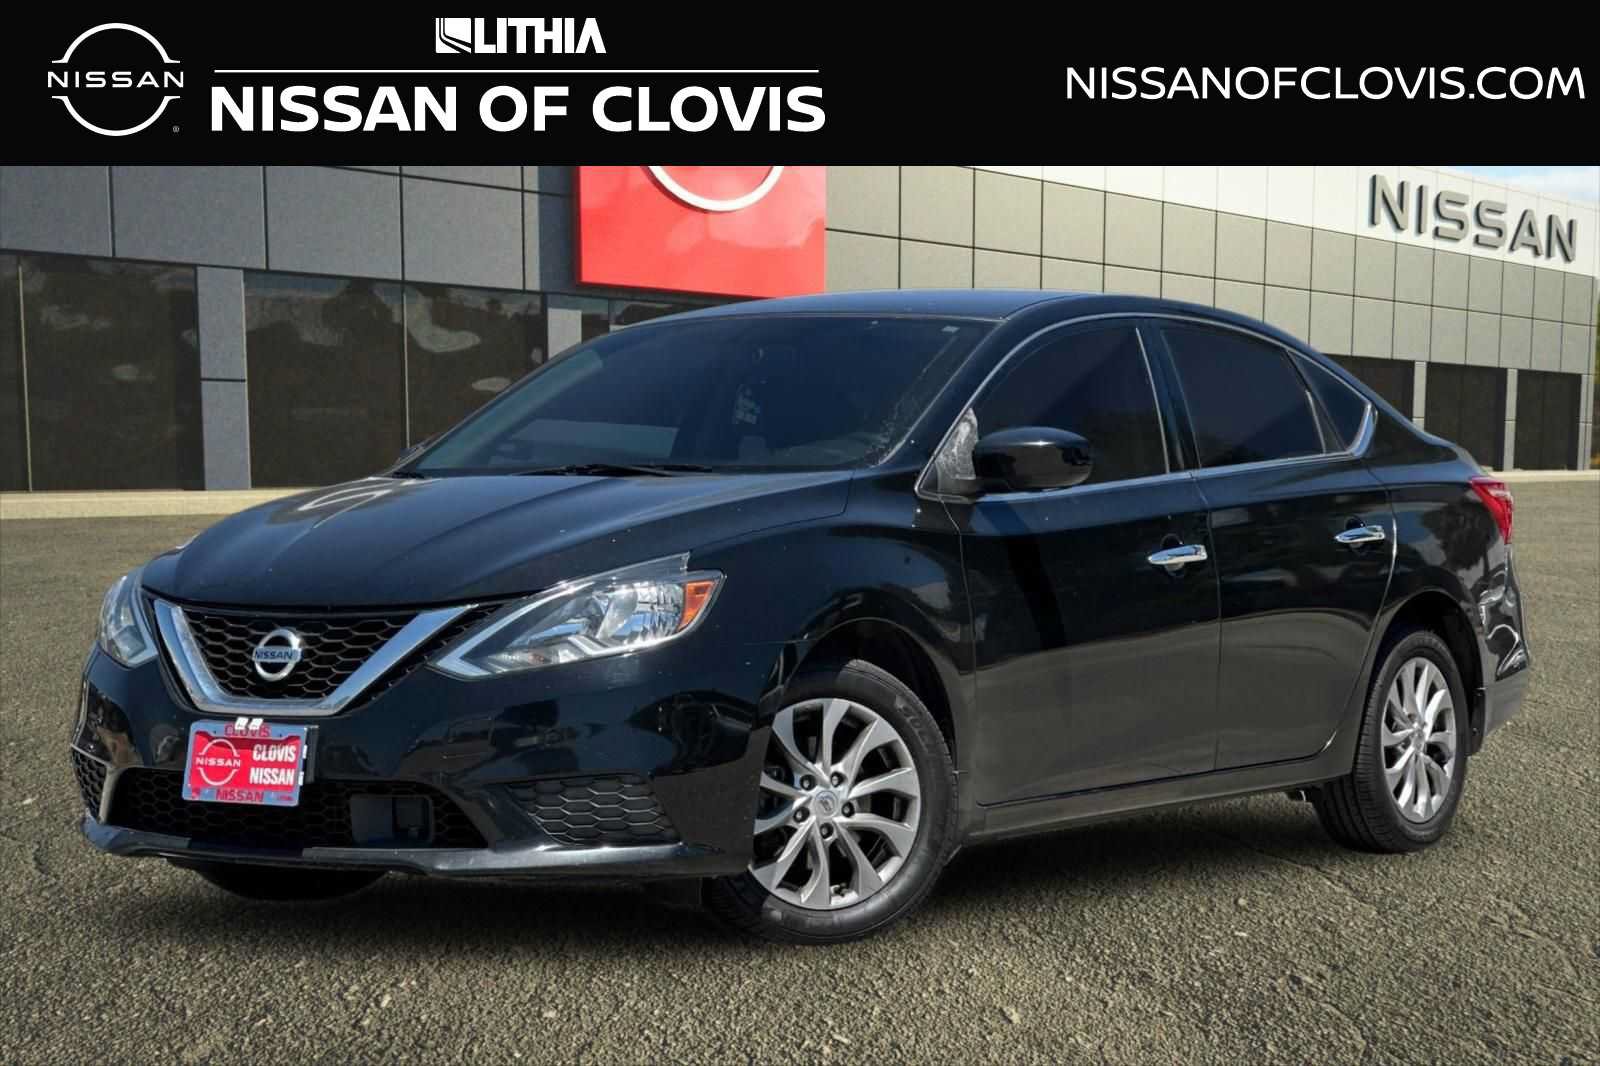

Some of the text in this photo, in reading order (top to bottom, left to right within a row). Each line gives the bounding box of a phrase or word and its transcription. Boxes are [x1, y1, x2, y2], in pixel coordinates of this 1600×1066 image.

[1368, 173, 1577, 263] NISSAN
[255, 649, 293, 660] NISSAN
[252, 744, 296, 762] CLOVIS
[195, 757, 241, 767] NISSAN
[249, 767, 295, 785] NISSAN
[215, 788, 264, 802] NISSAN
